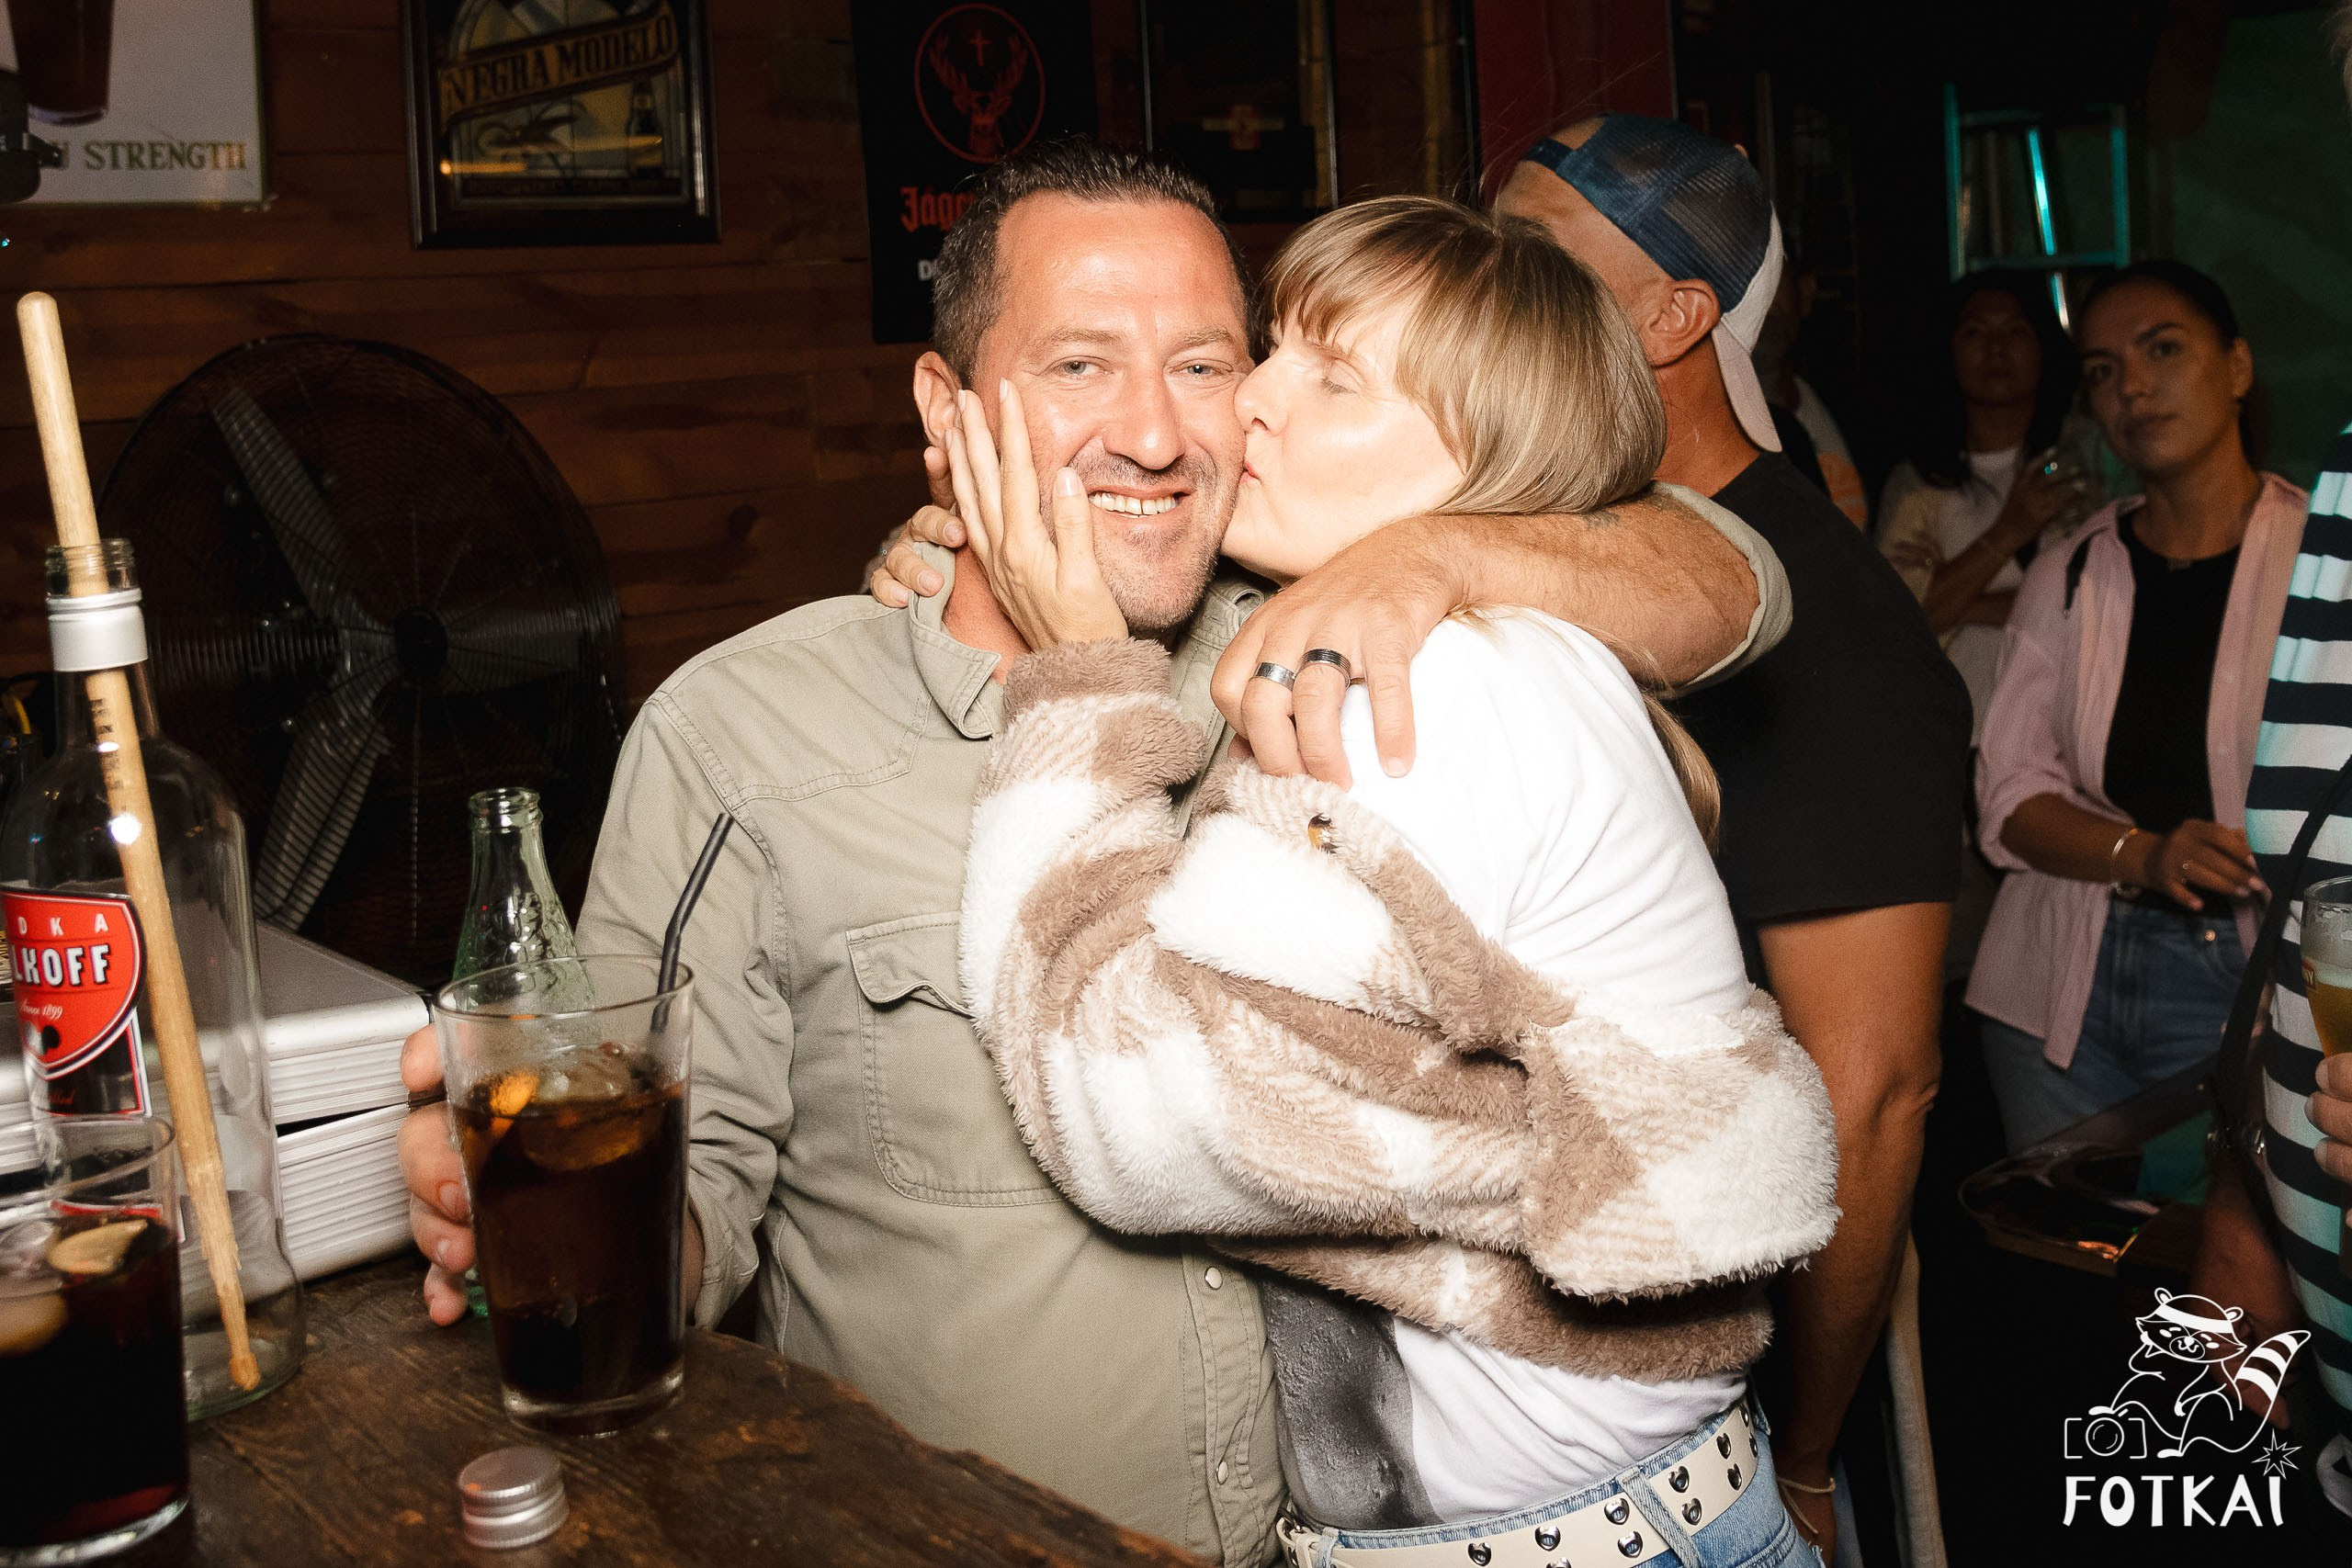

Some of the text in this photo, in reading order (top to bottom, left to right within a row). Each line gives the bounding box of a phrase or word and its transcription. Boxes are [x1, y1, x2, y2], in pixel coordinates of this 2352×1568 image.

[447, 14, 674, 106] NEGRA MODELO
[83, 141, 247, 171] STRENGTH
[42, 1003, 63, 1020] 1899
